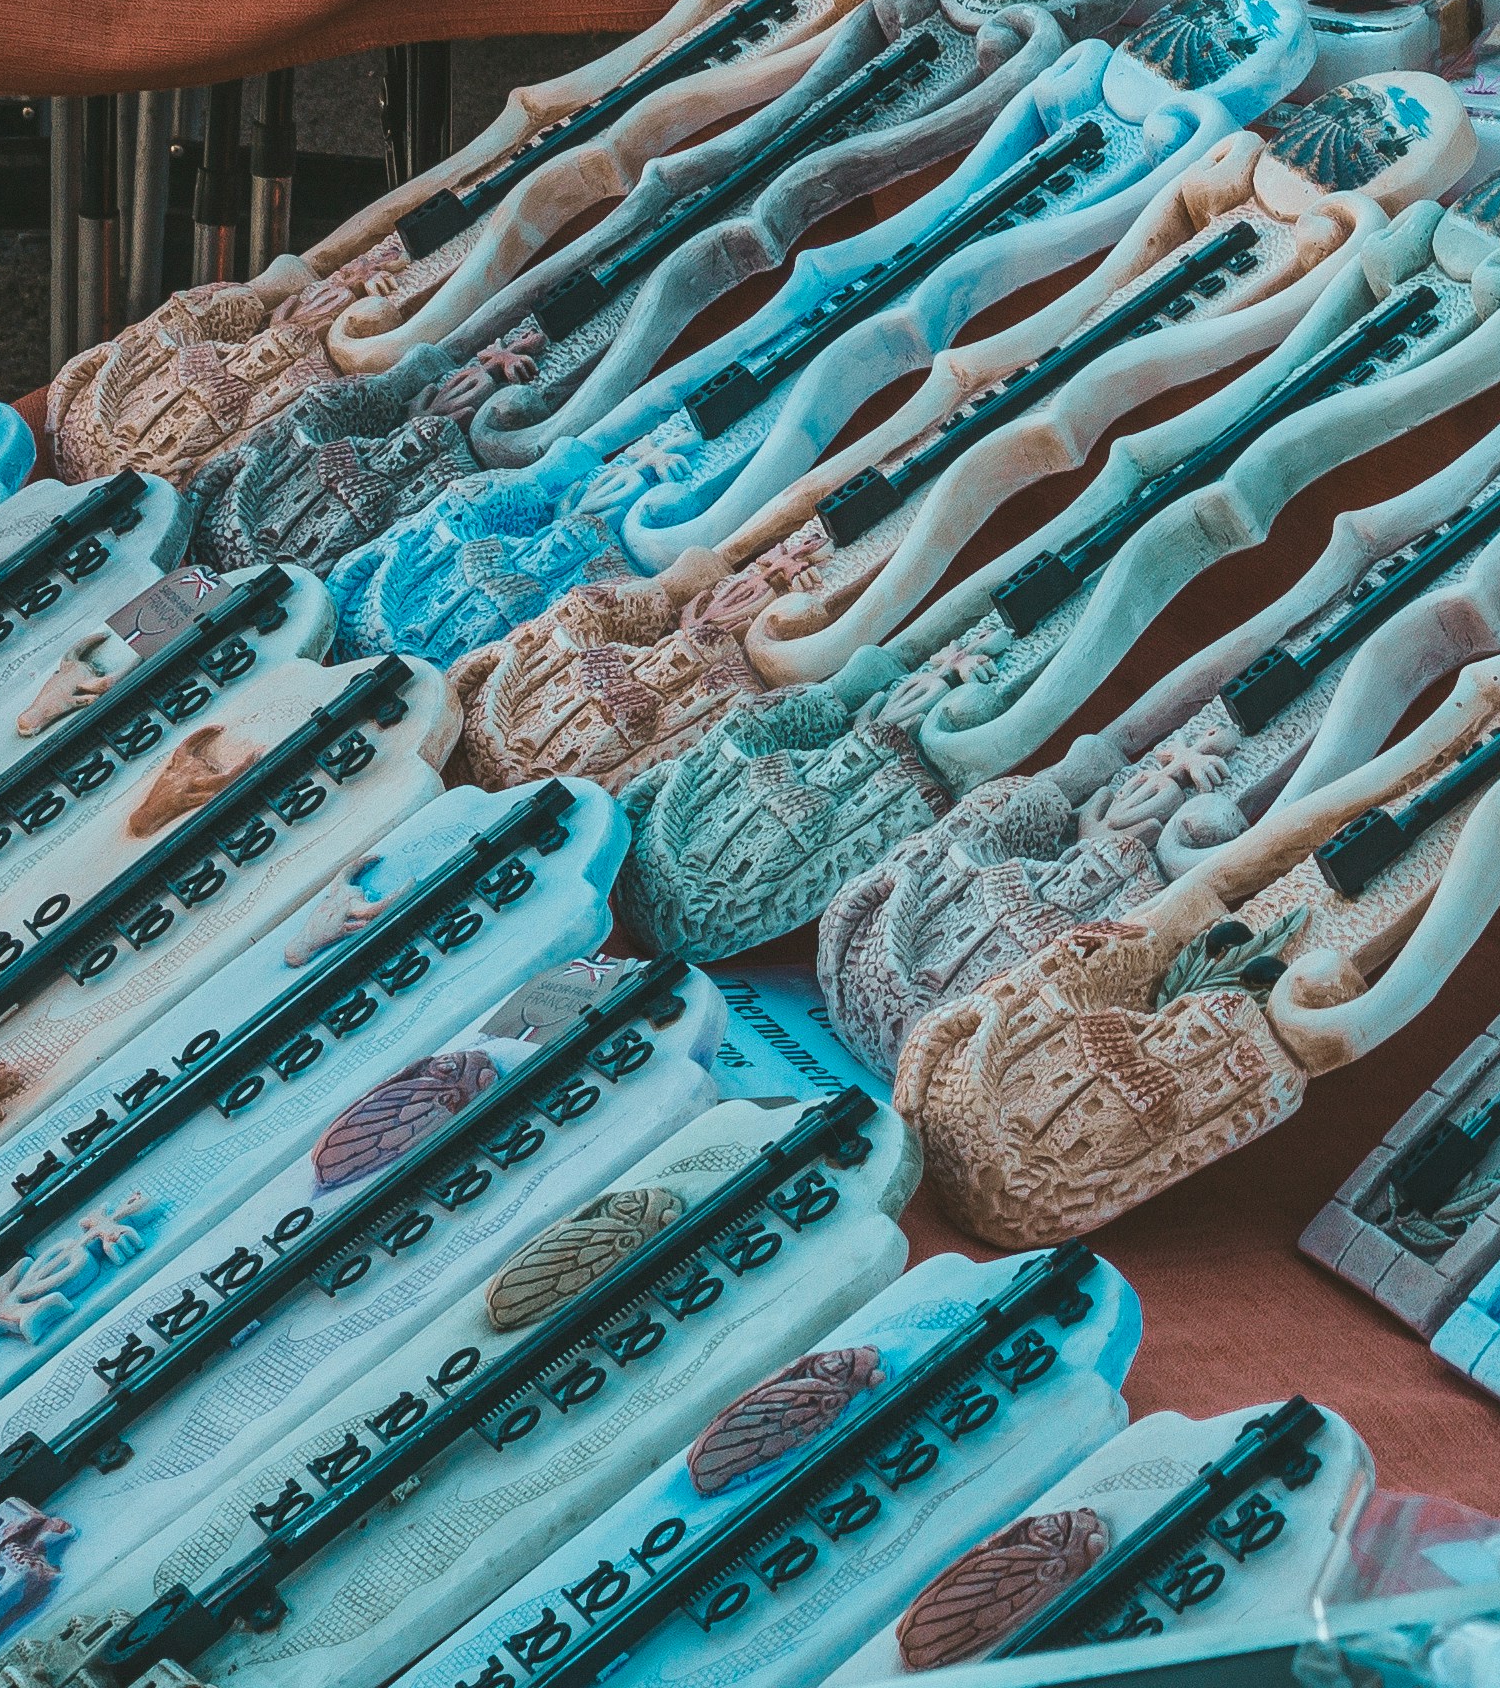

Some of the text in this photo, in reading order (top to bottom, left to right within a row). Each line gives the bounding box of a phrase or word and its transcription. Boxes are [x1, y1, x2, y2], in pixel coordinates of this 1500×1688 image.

[57, 536, 110, 584] 50
[201, 636, 256, 687] 50
[314, 725, 376, 785] 50
[269, 771, 326, 826] 40
[220, 814, 276, 867] 30
[170, 859, 226, 909] 20
[474, 857, 535, 912] 50
[24, 894, 80, 942] 0
[120, 903, 174, 950] 10
[426, 899, 482, 954] 40
[69, 943, 117, 986] 0
[372, 945, 429, 996] 30
[320, 988, 378, 1038] 20
[716, 977, 843, 1097] Thermometr
[173, 1030, 219, 1071] 0
[268, 1033, 323, 1081] 10
[589, 1028, 653, 1083] 50
[213, 1076, 264, 1118] 0
[537, 1068, 600, 1127] 40
[483, 1112, 545, 1170] 30
[433, 1162, 492, 1211] 20
[768, 1170, 839, 1233] 50
[263, 1207, 313, 1259] 0
[377, 1203, 433, 1257] 10
[715, 1221, 781, 1277] 40
[201, 1247, 270, 1300] 10
[320, 1249, 371, 1297] 0
[659, 1263, 723, 1322] 30
[147, 1289, 214, 1344] 20
[602, 1310, 666, 1367] 20
[93, 1333, 155, 1392] 30
[427, 1347, 491, 1401] 0
[544, 1359, 606, 1413] 10
[990, 1329, 1057, 1394] 50
[365, 1392, 428, 1445] 10
[485, 1405, 540, 1452] 0
[929, 1384, 998, 1442] 40
[307, 1433, 371, 1492] 20
[869, 1424, 939, 1492] 30
[250, 1478, 314, 1539] 30
[813, 1483, 881, 1542] 20
[1212, 1493, 1285, 1563] 50
[630, 1518, 700, 1579] 0
[751, 1536, 817, 1592] 10
[561, 1561, 640, 1627] 10
[691, 1583, 750, 1632] 0
[1153, 1552, 1224, 1614] 40
[503, 1608, 571, 1676] 20
